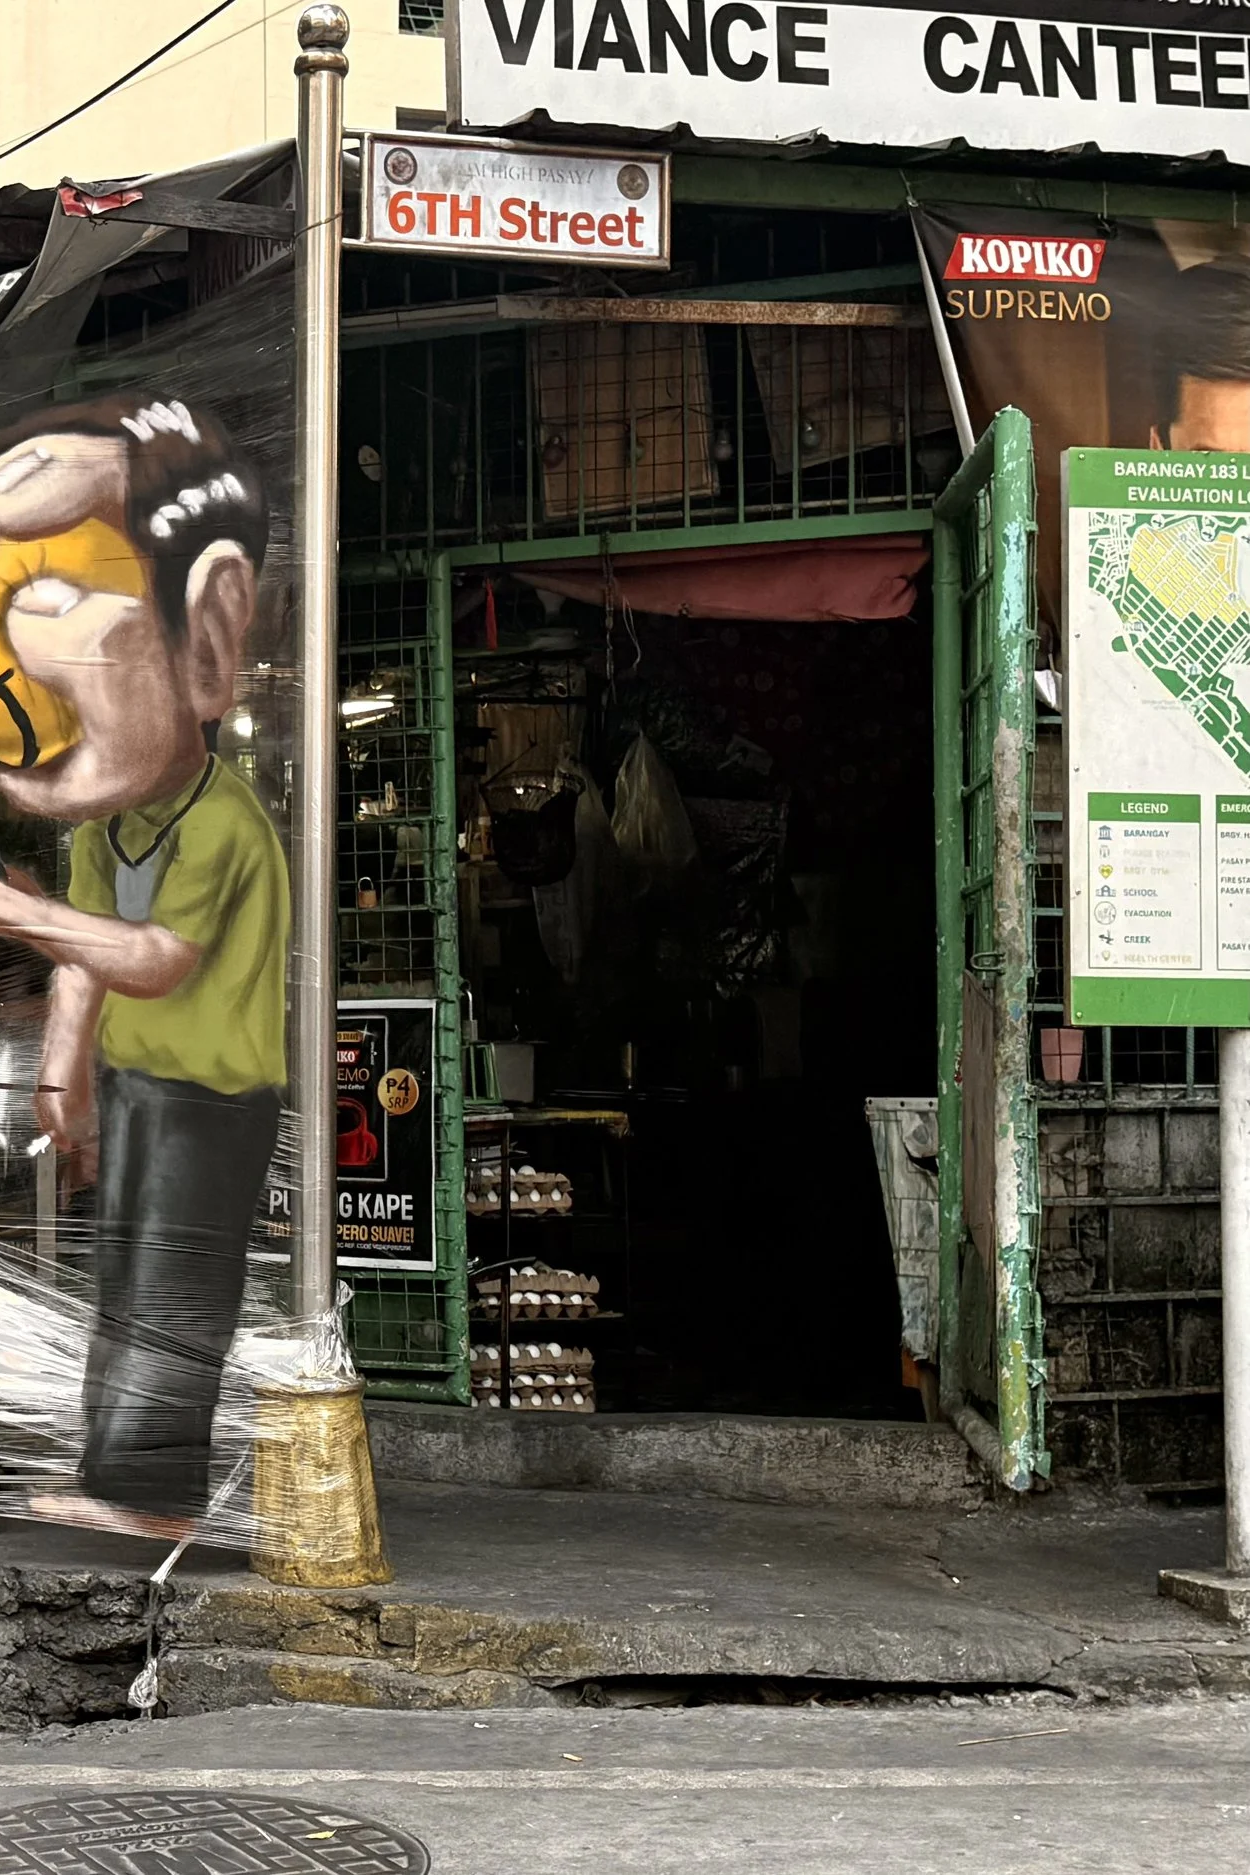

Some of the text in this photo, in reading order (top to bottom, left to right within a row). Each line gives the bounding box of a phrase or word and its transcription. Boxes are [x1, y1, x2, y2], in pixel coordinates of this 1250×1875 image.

[484, 0, 1250, 110] VIANCE CANTEE
[491, 163, 533, 181] HIGH
[388, 191, 645, 248] 6TH Street
[961, 237, 1094, 278] KOPIKO
[945, 289, 1112, 322] SUPREMO
[1114, 461, 1206, 478] BARANGAY
[1210, 465, 1238, 479] 183
[1128, 486, 1233, 504] EVALUATION
[1121, 802, 1169, 814] LEGEND
[1123, 829, 1170, 838] BARANGAY
[1123, 888, 1158, 897] SCHOOL
[1124, 909, 1172, 918] EVACUATION
[1124, 935, 1151, 944] CREEK
[387, 1096, 410, 1108] SRP
[358, 1193, 413, 1221] KAPE
[371, 1226, 414, 1243] SUAVE!
